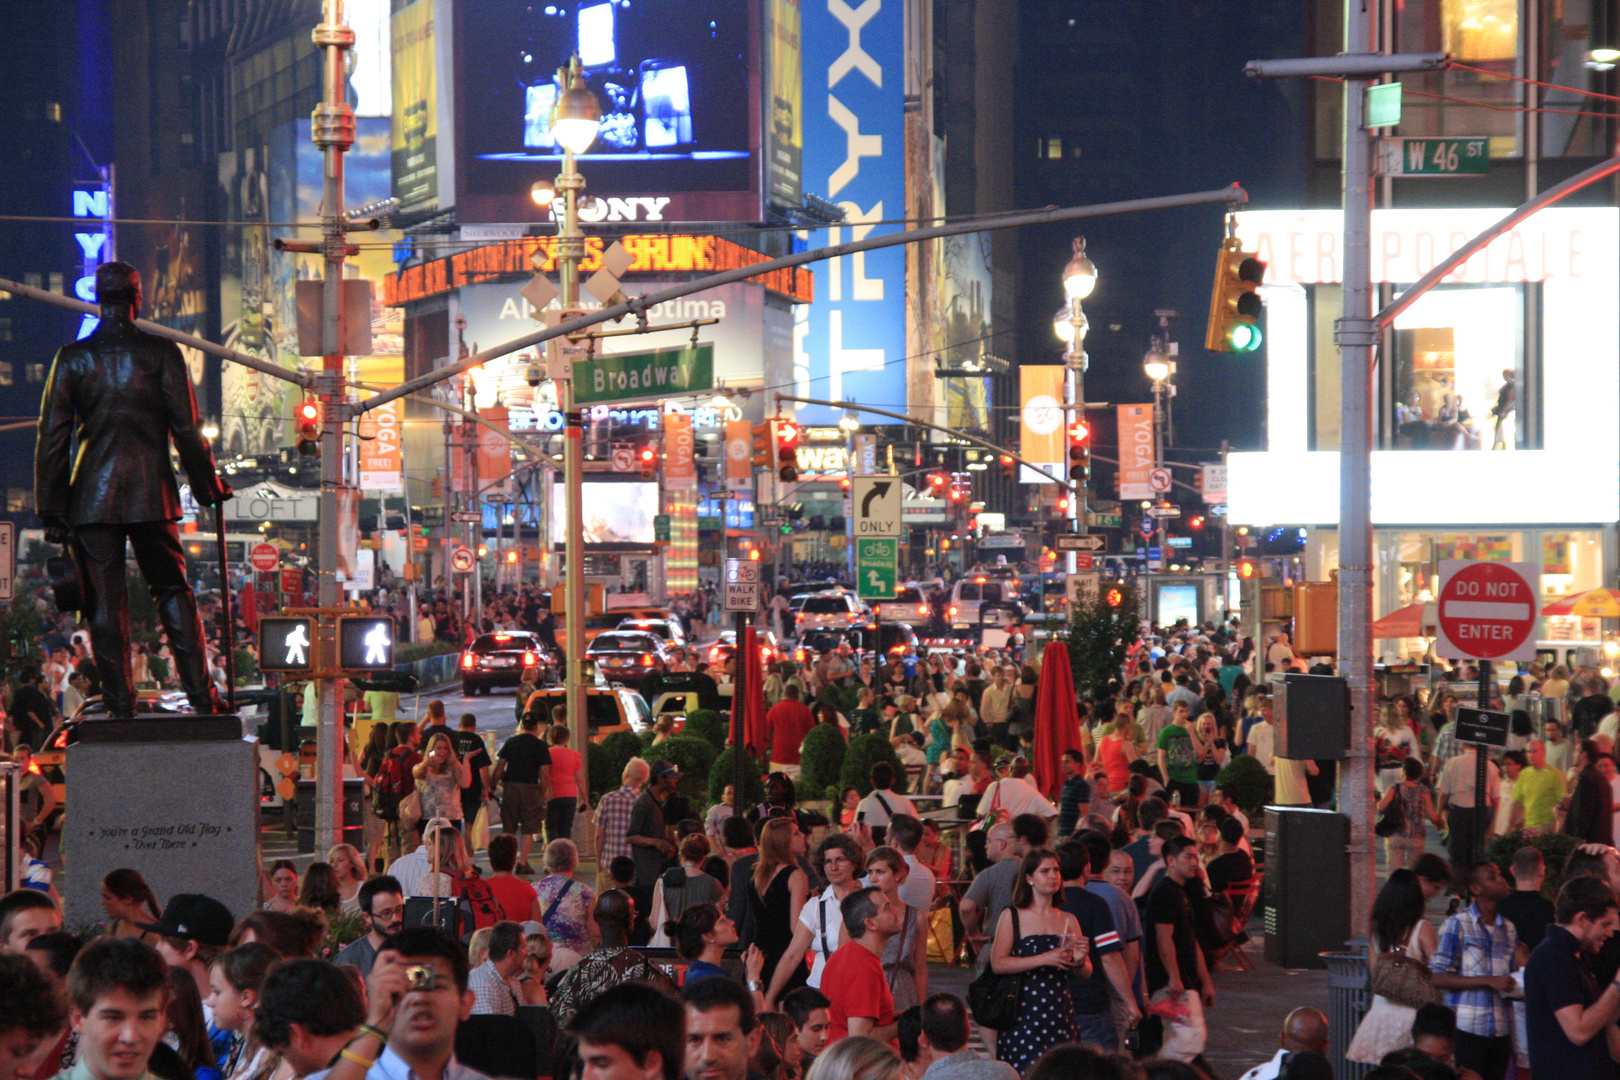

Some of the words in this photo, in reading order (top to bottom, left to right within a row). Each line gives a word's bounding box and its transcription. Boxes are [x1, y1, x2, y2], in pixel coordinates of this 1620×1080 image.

[1409, 141, 1426, 171] W
[1432, 141, 1459, 171] 46
[1466, 141, 1485, 157] ST
[463, 229, 520, 238] SHERWOOD
[593, 363, 693, 392] Broadway
[377, 401, 396, 455] YOGA
[676, 426, 690, 465] YOGA
[1134, 420, 1152, 468] YOGA
[367, 458, 392, 467] FREE!
[864, 444, 875, 474] YOGA
[236, 500, 303, 518] LOFT
[860, 521, 894, 532] ONLY
[1083, 539, 1099, 547] WAY
[861, 558, 893, 568] Broadway
[729, 585, 755, 594] WALK
[1456, 581, 1479, 596] DO
[1486, 582, 1520, 597] NOT
[731, 596, 752, 606] BIKE
[1459, 624, 1513, 640] ENTER
[131, 828, 138, 836] a
[141, 826, 174, 838] Grand
[177, 824, 196, 835] Old
[198, 822, 222, 837] Flag
[132, 838, 157, 849] Over
[158, 838, 187, 849] There
